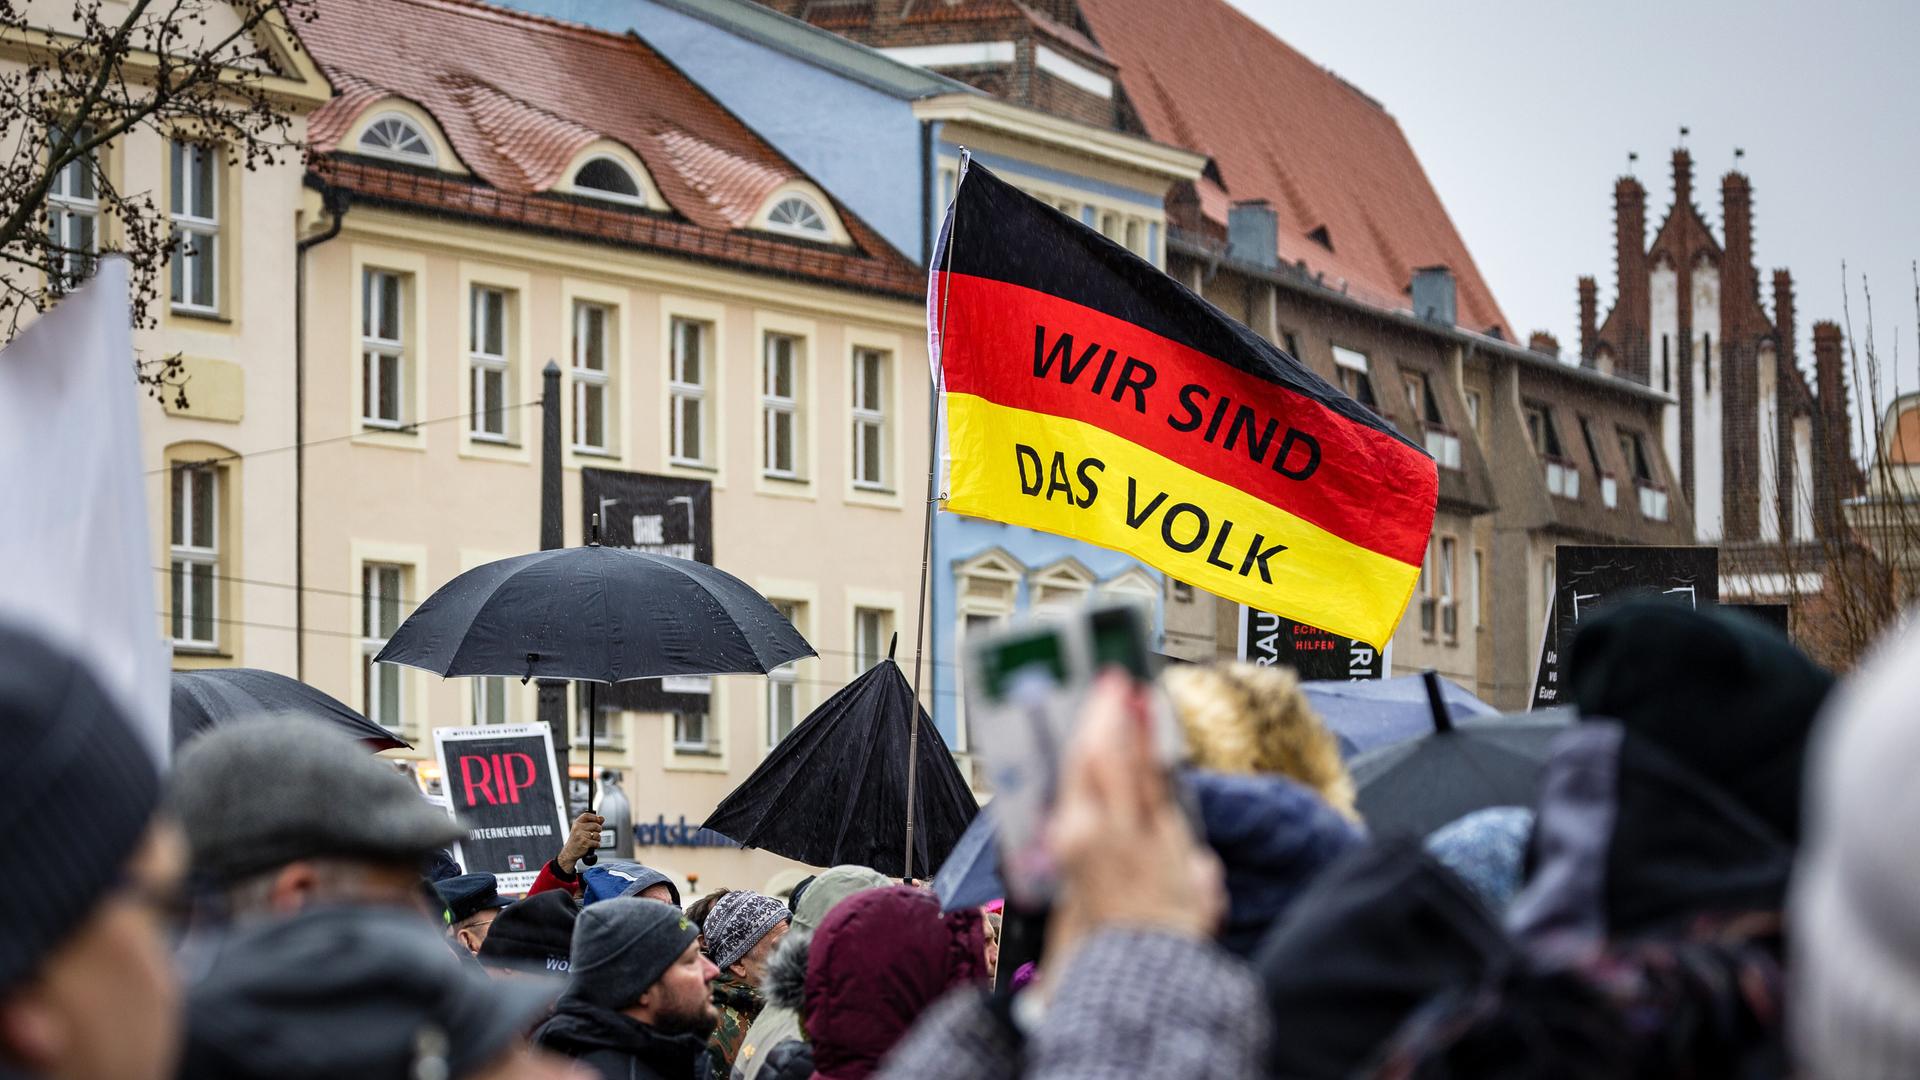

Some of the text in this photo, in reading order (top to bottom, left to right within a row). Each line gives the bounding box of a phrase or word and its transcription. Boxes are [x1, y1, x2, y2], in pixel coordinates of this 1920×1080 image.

[1032, 324, 1322, 481] WIR SIND
[1015, 443, 1289, 584] DAS VOLK
[1295, 640, 1336, 651] HILFEN
[459, 752, 537, 807] RIP
